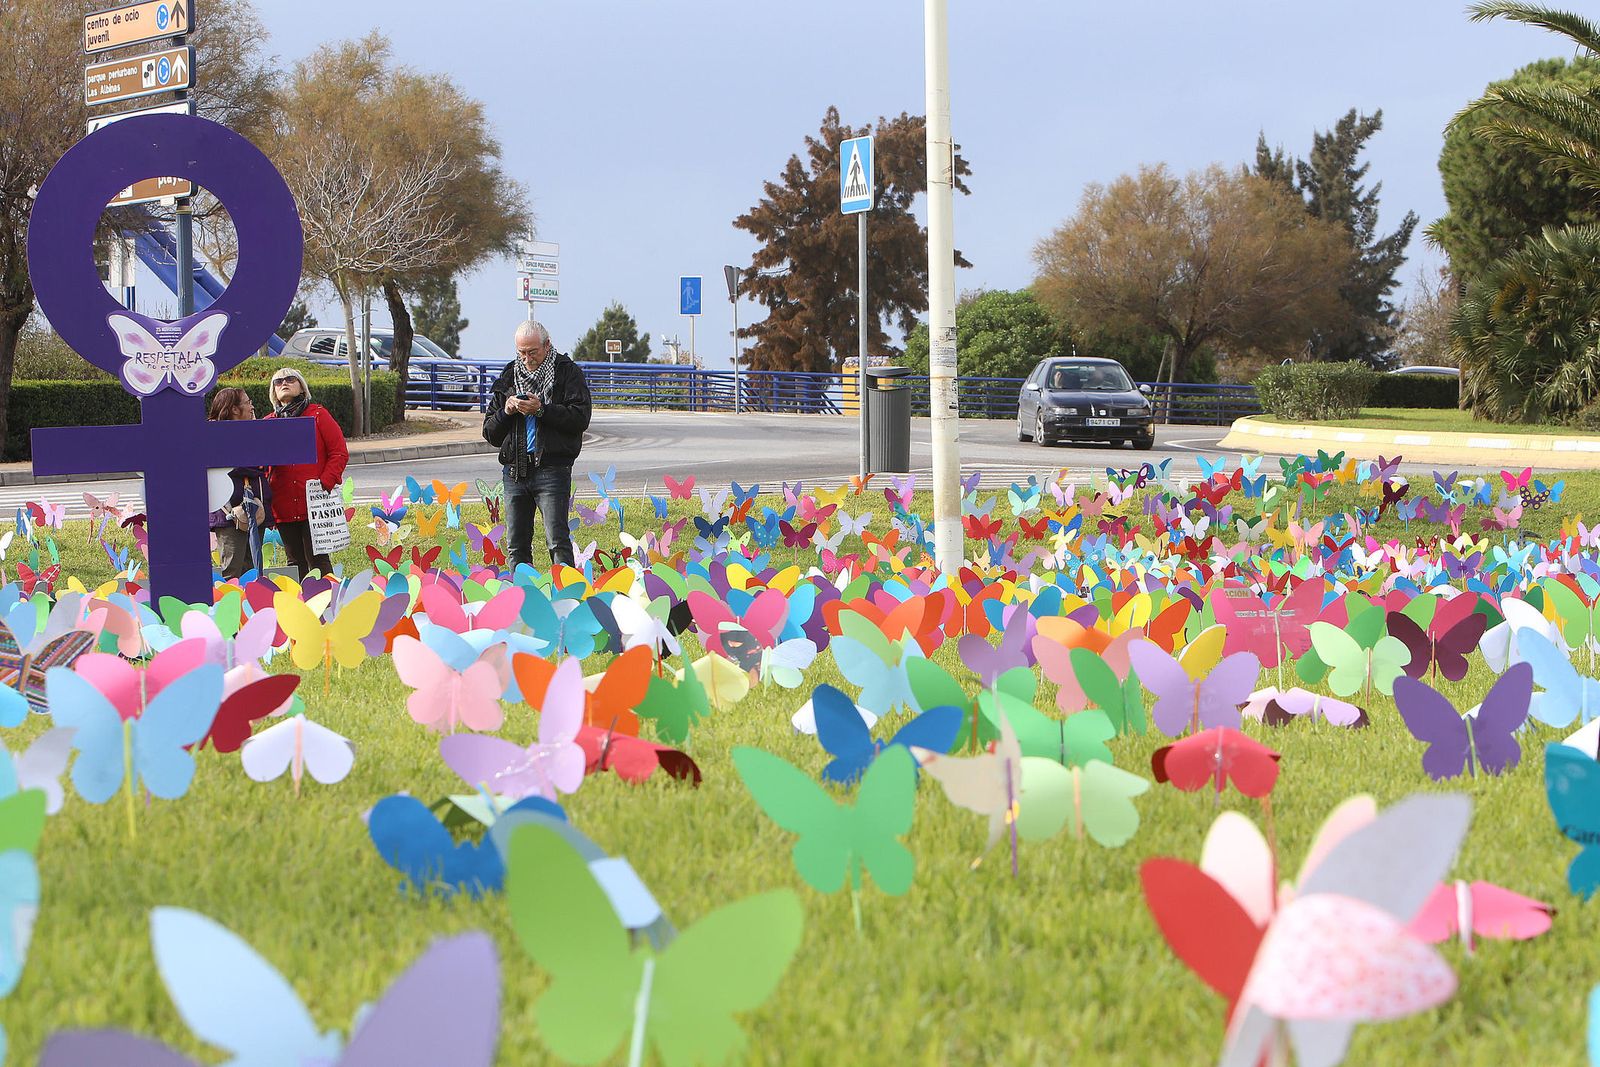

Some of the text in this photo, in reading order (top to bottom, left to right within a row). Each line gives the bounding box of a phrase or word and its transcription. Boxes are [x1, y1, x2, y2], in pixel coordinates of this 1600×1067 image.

[87, 9, 139, 30] centro de ocio
[87, 30, 109, 48] juvenil
[87, 72, 106, 85] parque
[88, 87, 98, 97] Las
[530, 287, 558, 296] MERCADONA
